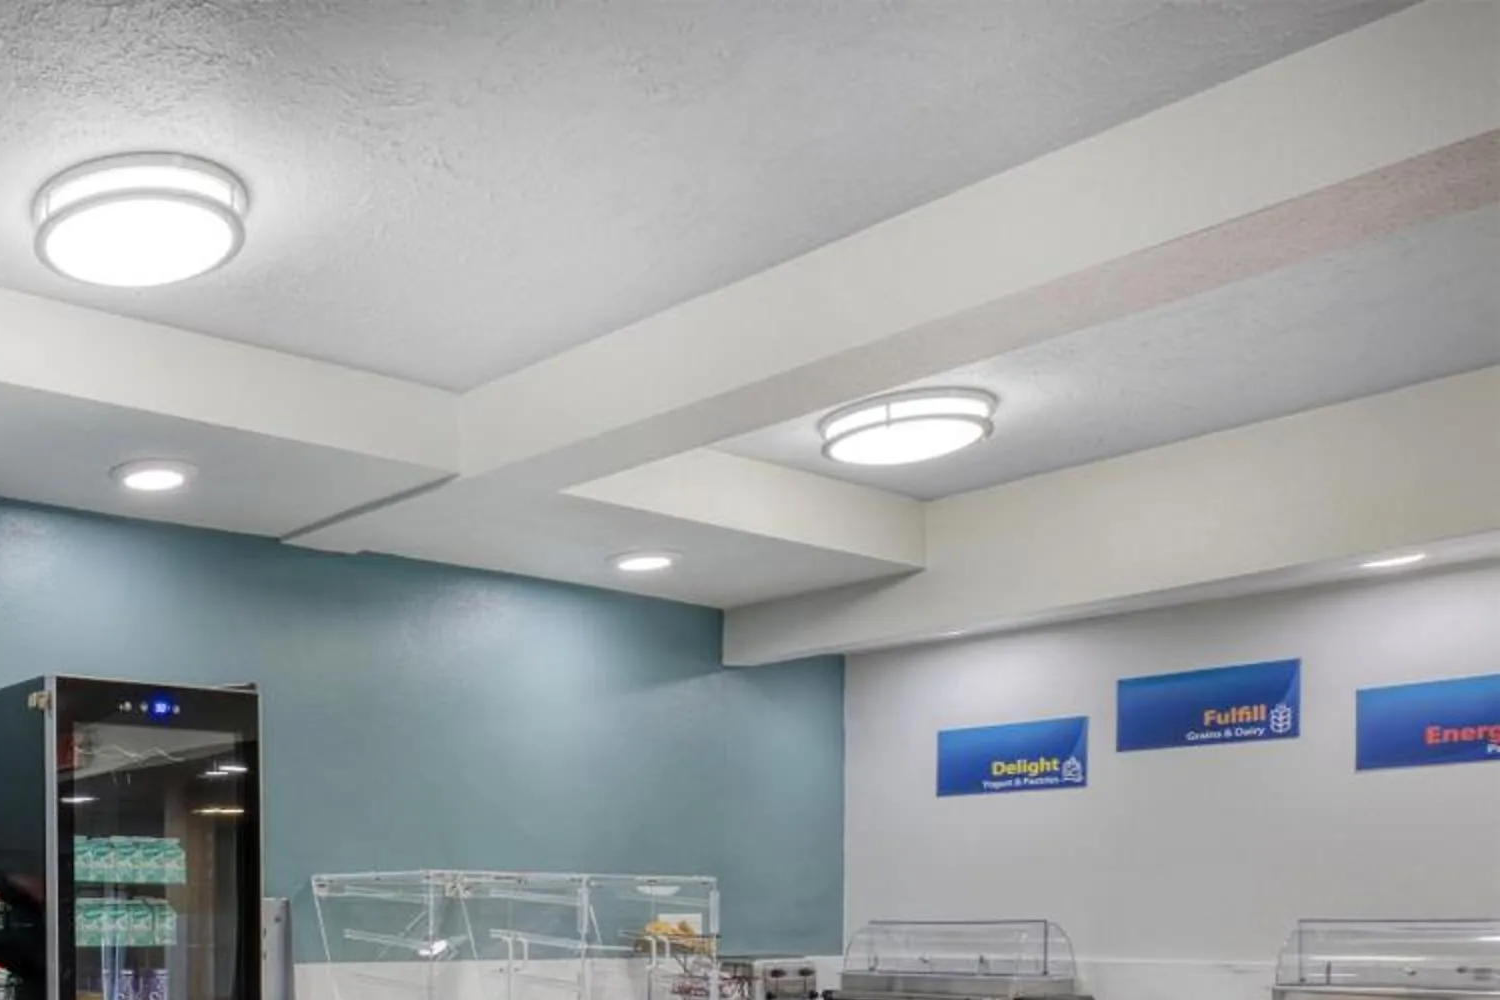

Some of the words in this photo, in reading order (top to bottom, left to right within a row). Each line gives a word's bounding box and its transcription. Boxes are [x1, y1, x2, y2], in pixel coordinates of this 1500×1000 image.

[1203, 704, 1267, 727] Fulfill
[1186, 730, 1222, 741] Grains
[1223, 728, 1233, 738] &
[1234, 727, 1266, 737] Dairy
[992, 757, 1060, 777] Delight
